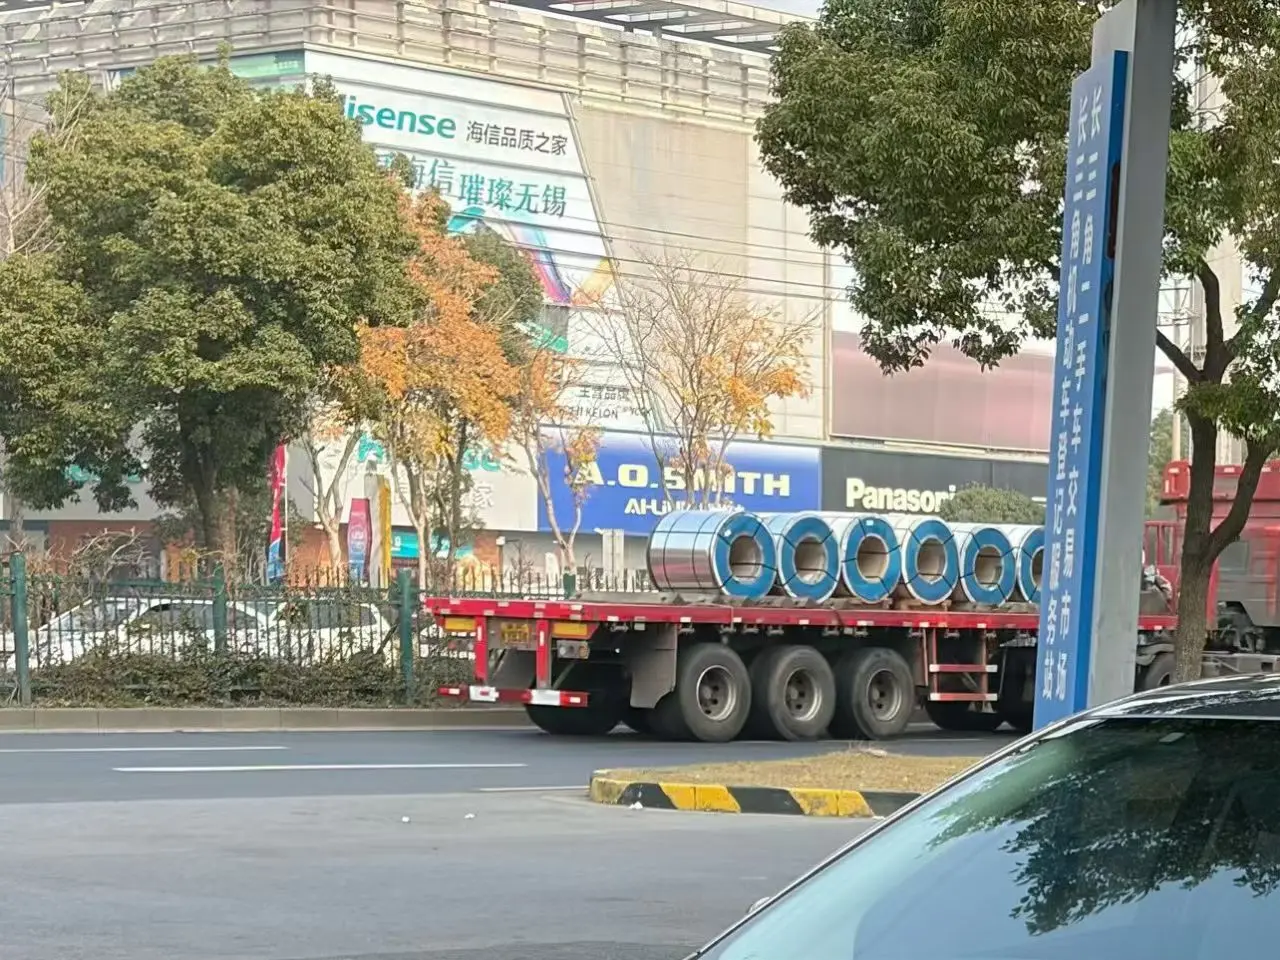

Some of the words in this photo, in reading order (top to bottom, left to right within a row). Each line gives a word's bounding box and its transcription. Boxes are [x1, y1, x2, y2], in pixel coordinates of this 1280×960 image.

[343, 94, 457, 140] isense
[466, 120, 568, 157] 海信品质之家
[458, 173, 568, 219] 璀璨无锡
[1041, 95, 1089, 701] 长三角机动车登记服务站
[1053, 85, 1102, 701] 长三角二手车交易市场
[845, 477, 957, 513] Panasoni
